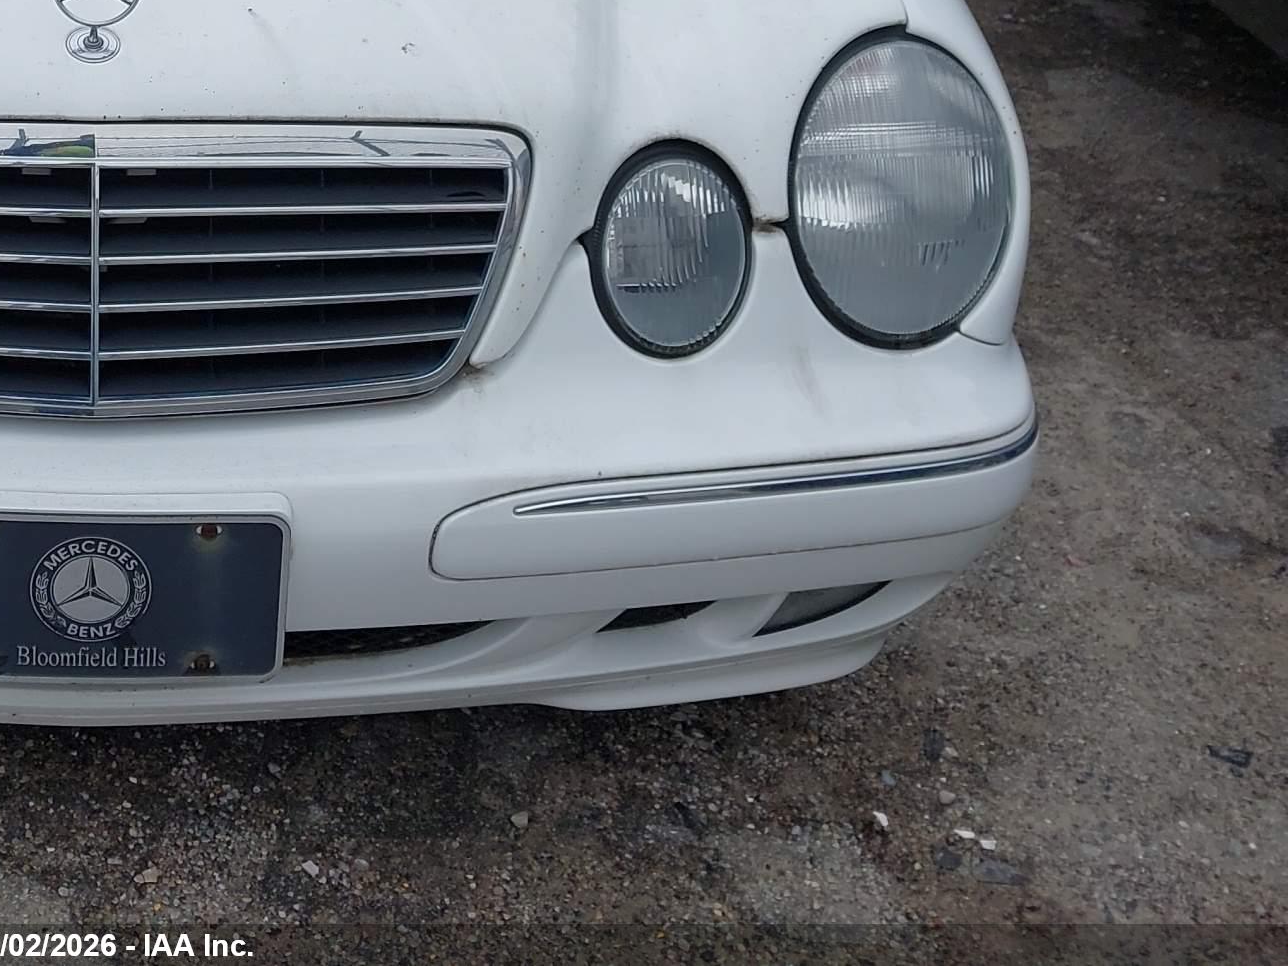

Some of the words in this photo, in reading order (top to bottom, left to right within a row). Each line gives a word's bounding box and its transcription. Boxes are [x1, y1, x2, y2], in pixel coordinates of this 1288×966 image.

[43, 539, 139, 573] MERCEDES
[66, 623, 117, 639] BENZ
[16, 645, 117, 668] Bloomfield
[123, 646, 166, 669] Hills
